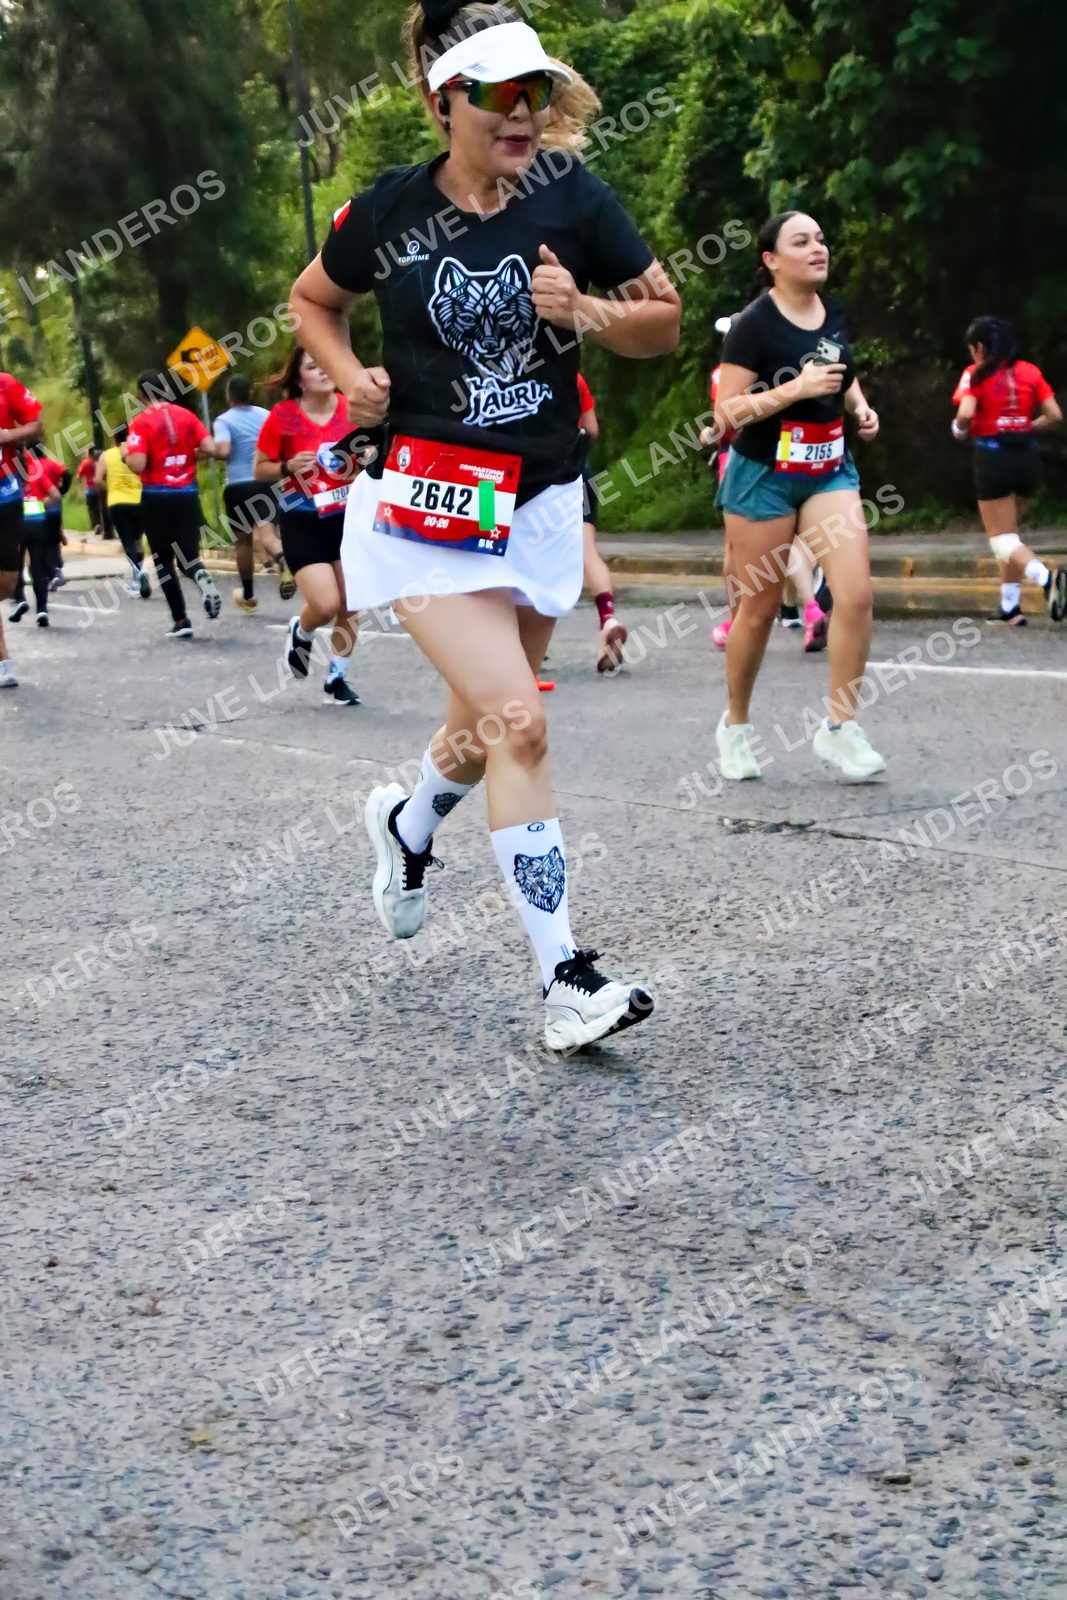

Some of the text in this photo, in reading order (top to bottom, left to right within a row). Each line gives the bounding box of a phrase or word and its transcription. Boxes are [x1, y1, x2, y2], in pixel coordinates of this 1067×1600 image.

[398, 253, 431, 264] TOPTIME
[804, 443, 833, 461] 2155
[410, 479, 473, 516] 2642
